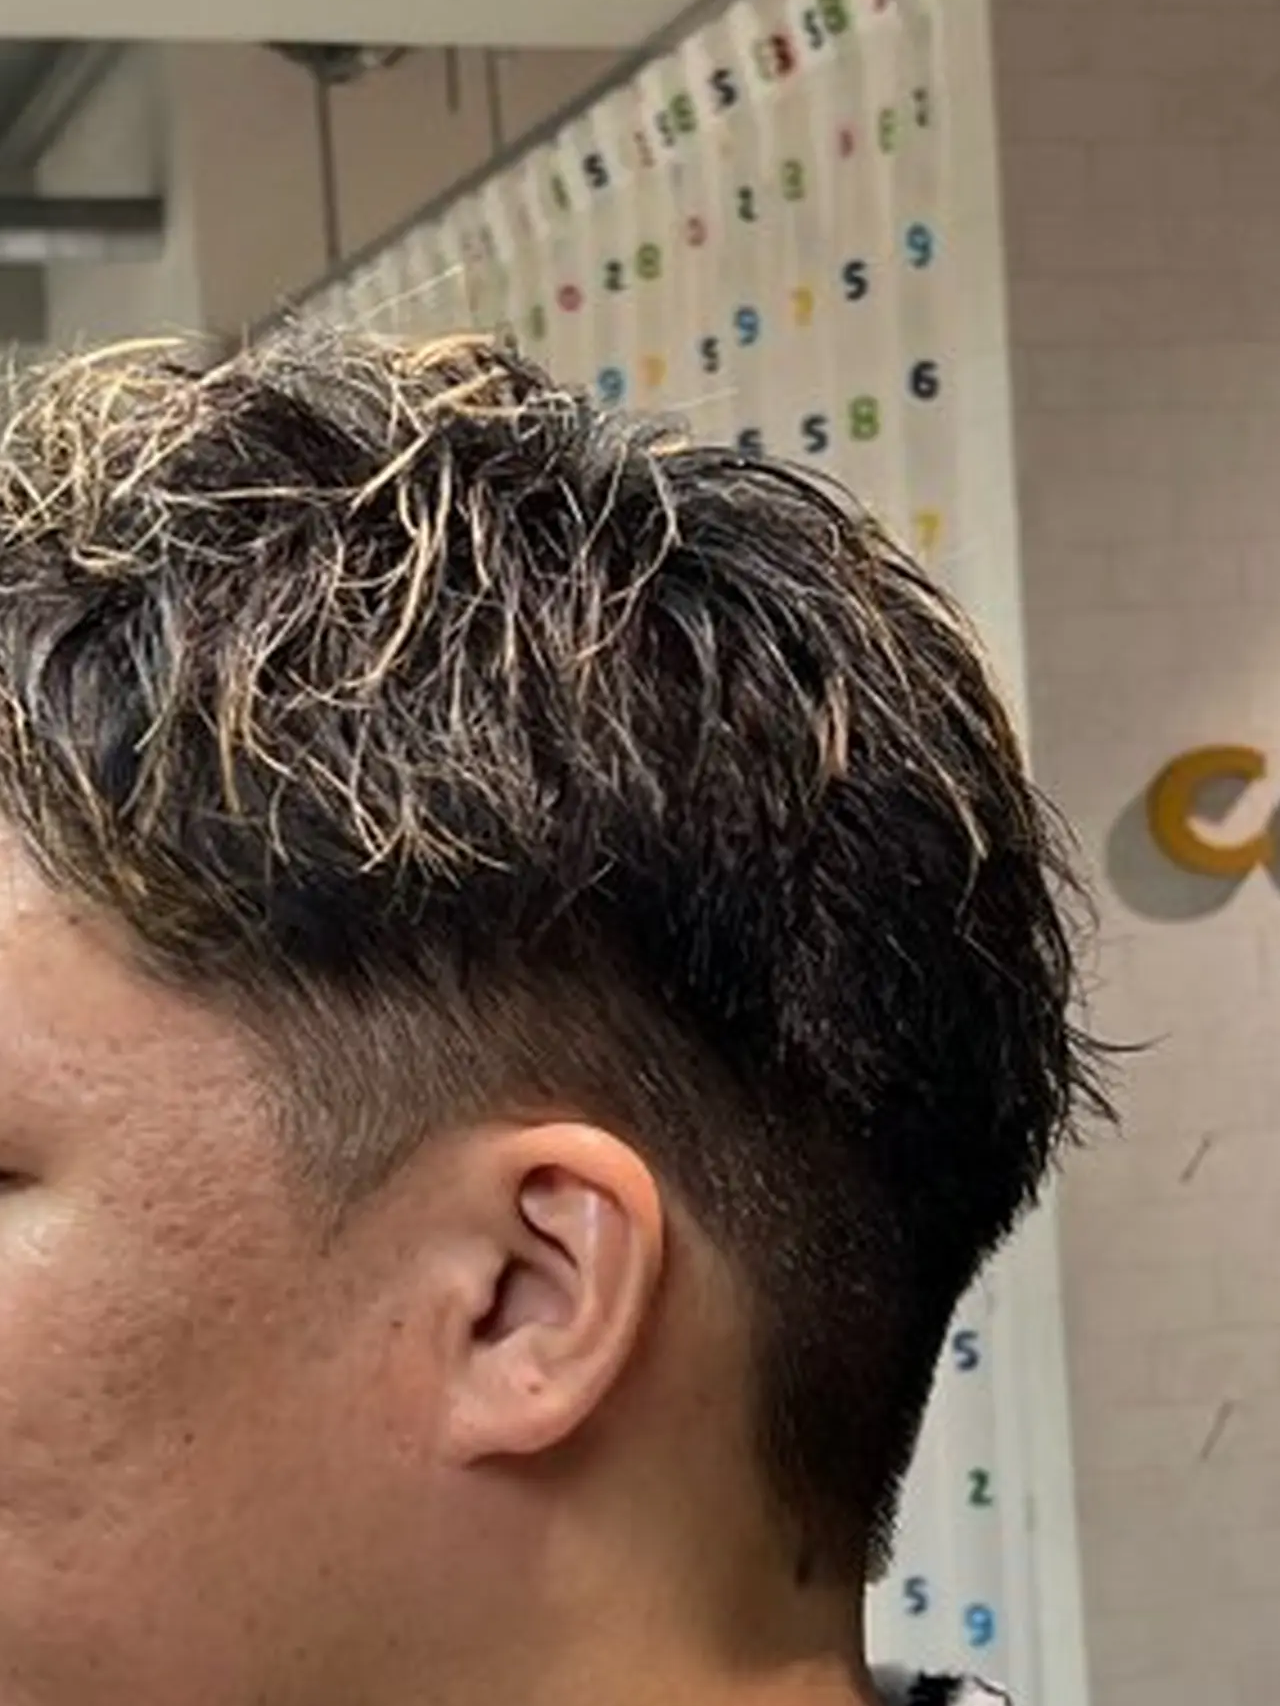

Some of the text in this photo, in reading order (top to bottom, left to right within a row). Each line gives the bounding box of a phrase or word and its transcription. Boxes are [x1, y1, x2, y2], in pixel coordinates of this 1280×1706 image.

[906, 222, 933, 268] 9
[842, 259, 868, 301] 5
[733, 306, 760, 346] 9
[910, 359, 939, 401] 6
[801, 414, 828, 453] 5
[849, 395, 879, 440] 8
[952, 1330, 979, 1371] 5
[967, 1467, 993, 1507] 2
[903, 1576, 928, 1615] 5
[963, 1603, 994, 1647] 9
